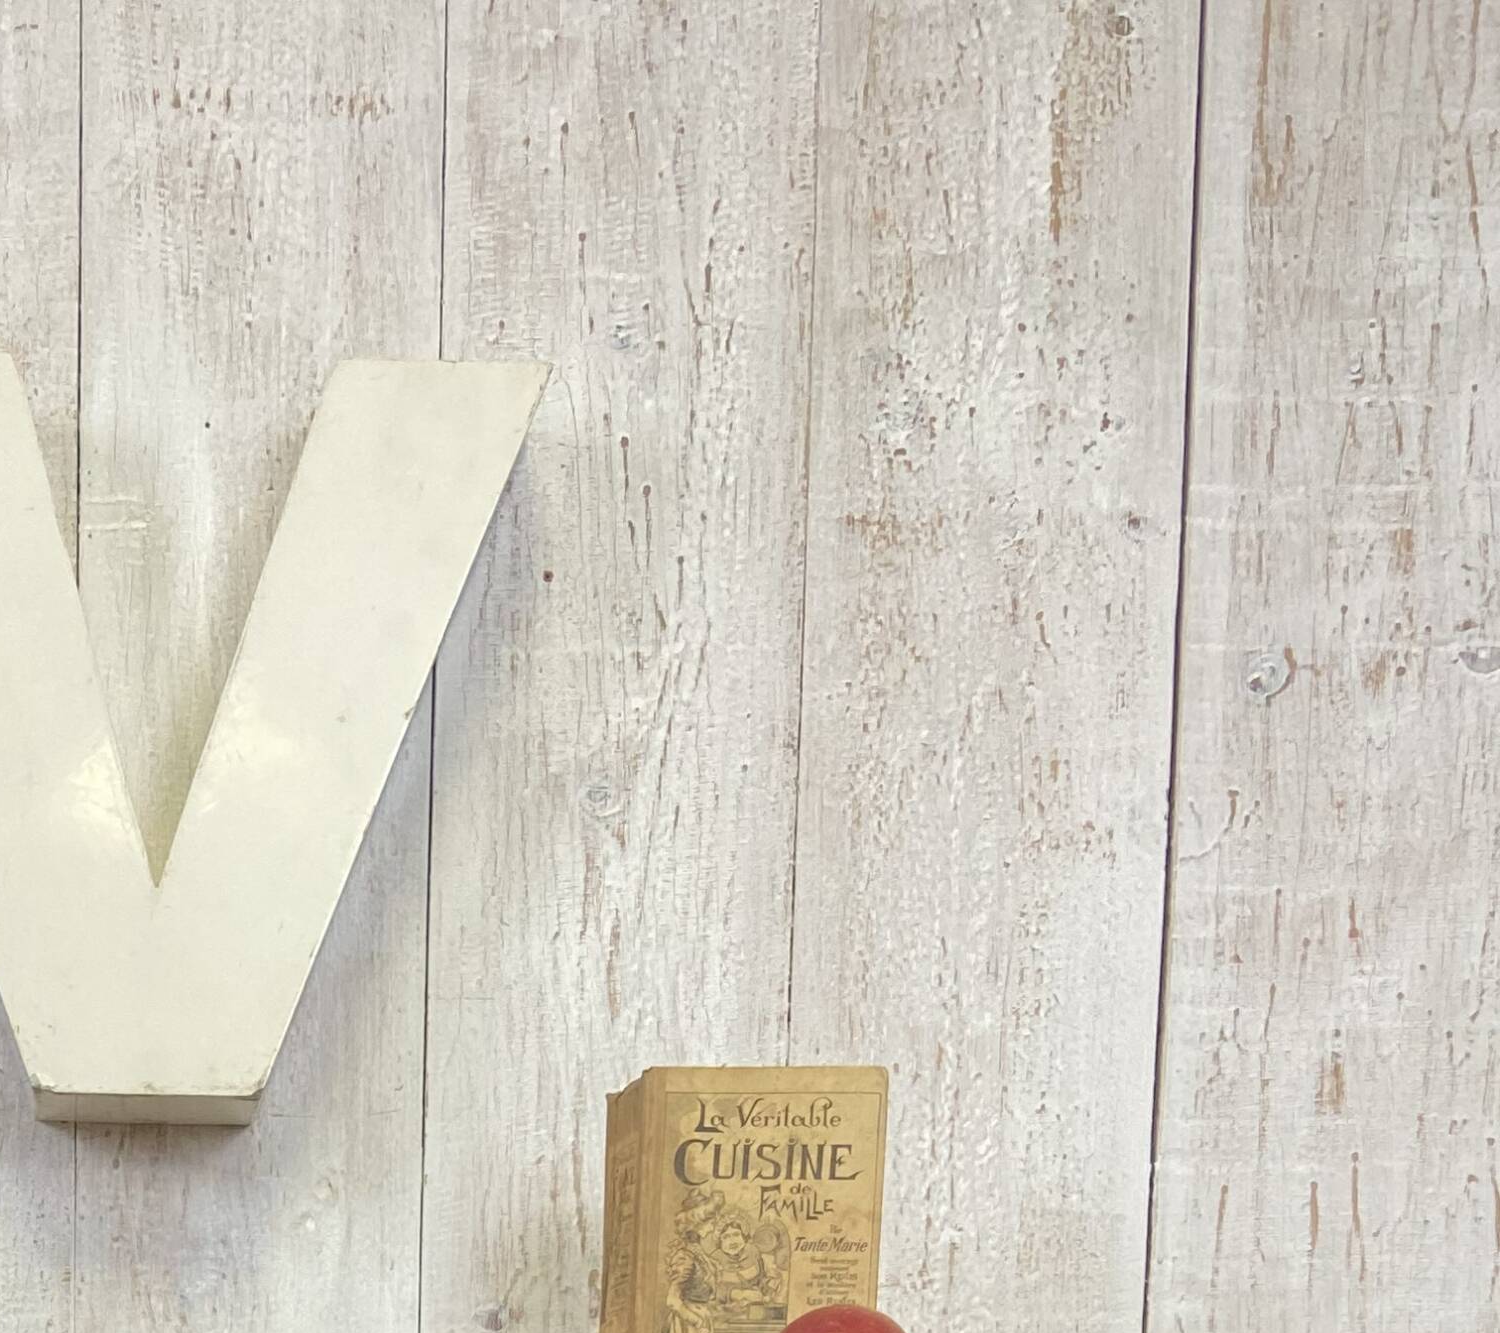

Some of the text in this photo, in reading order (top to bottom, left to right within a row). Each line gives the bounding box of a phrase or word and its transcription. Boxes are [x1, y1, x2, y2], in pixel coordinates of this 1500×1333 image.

[694, 1096, 842, 1133] La Véritable
[673, 1137, 865, 1186] CUISINE
[758, 1185, 835, 1222] FAMILLE
[790, 1183, 812, 1196] de
[794, 1236, 868, 1252] Tante Marie
